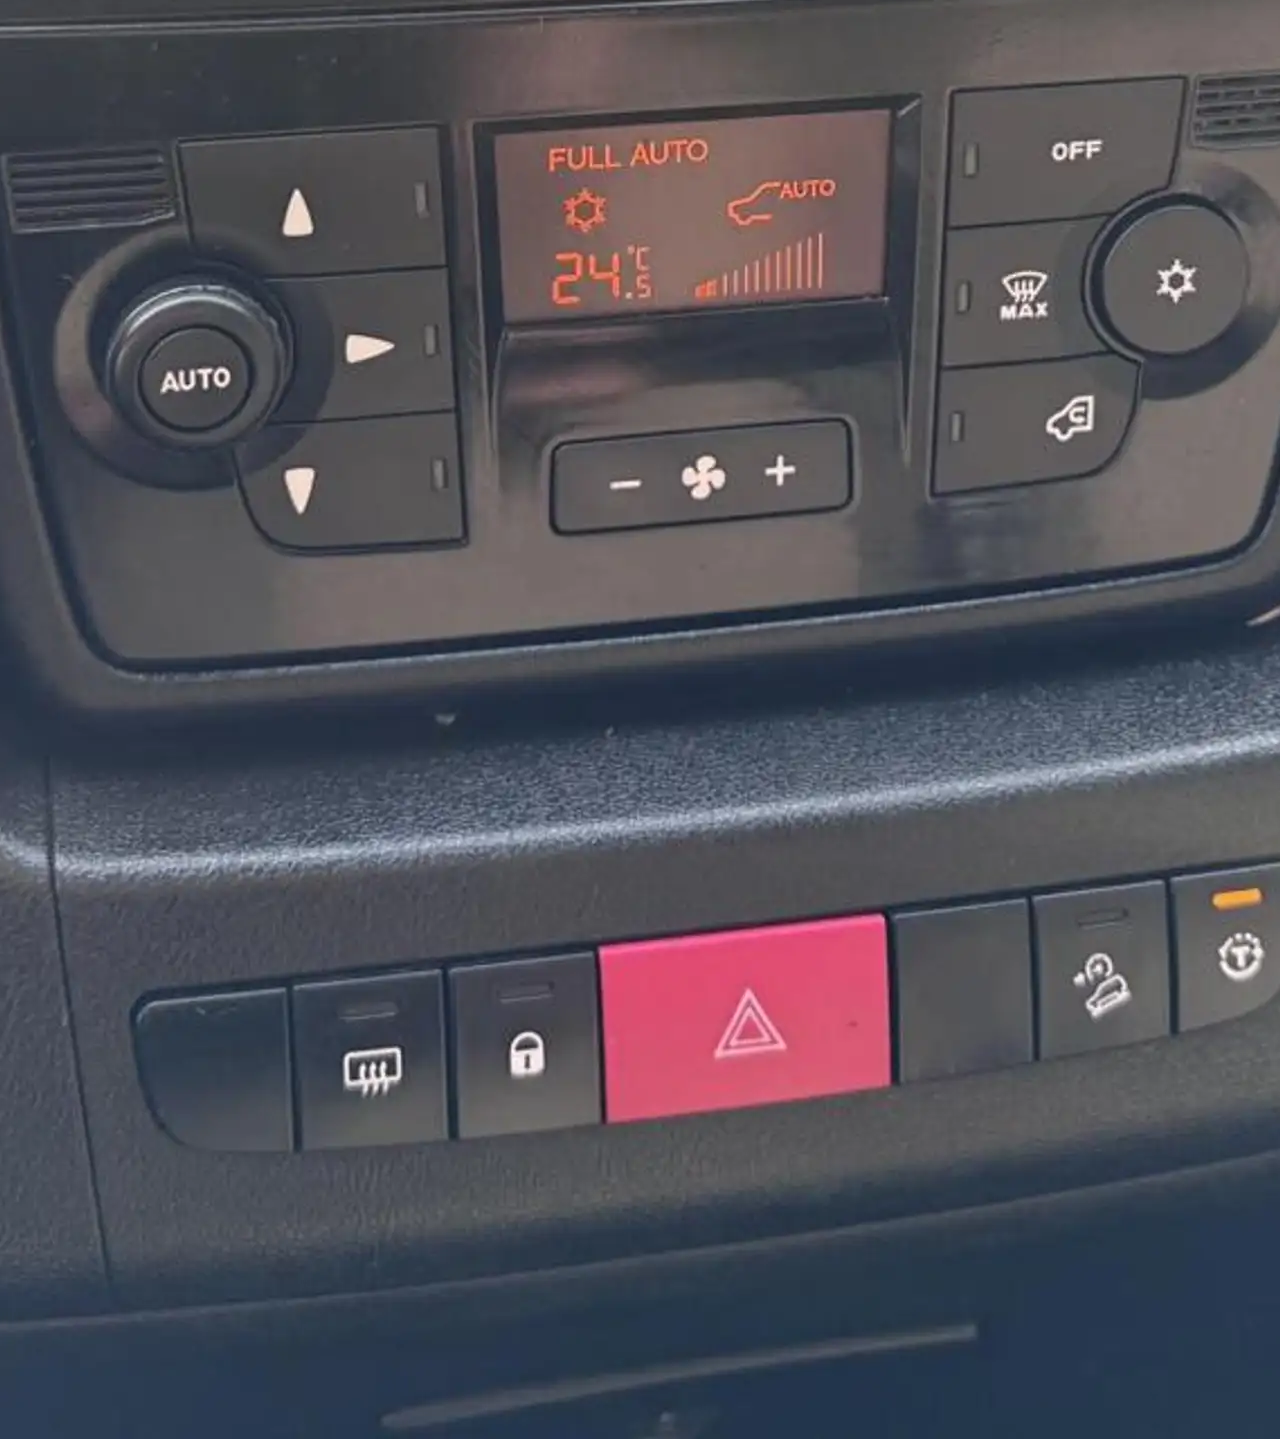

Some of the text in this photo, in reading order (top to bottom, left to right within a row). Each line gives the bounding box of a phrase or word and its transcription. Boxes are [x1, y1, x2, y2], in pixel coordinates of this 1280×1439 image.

[548, 138, 709, 172] FULL AUTO
[1052, 140, 1103, 161] OFF
[780, 179, 836, 199] AUTO
[999, 301, 1048, 321] MAX
[160, 366, 231, 393] AUTO
